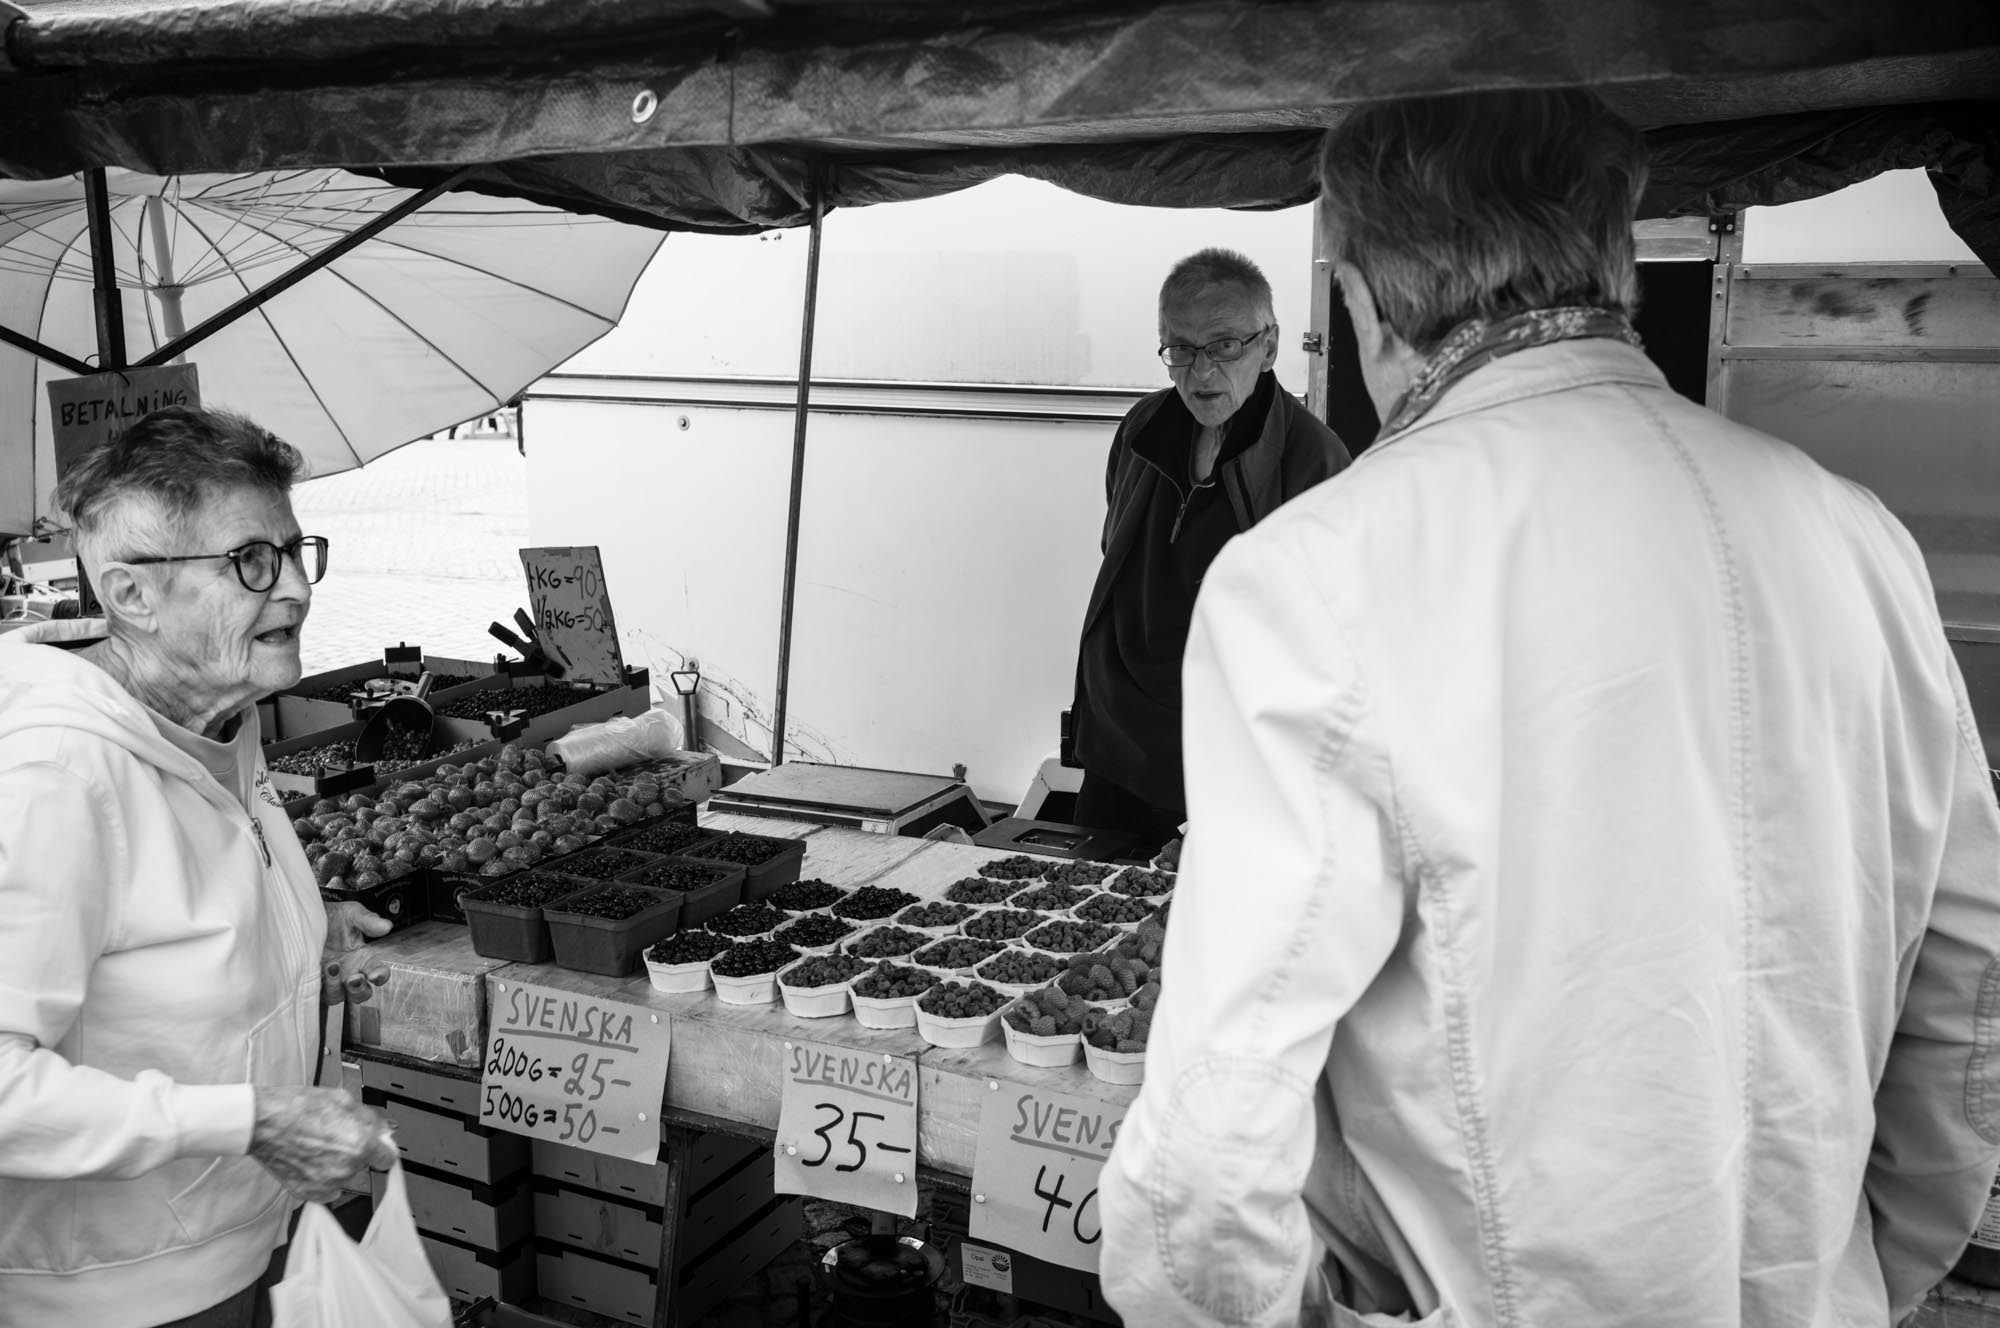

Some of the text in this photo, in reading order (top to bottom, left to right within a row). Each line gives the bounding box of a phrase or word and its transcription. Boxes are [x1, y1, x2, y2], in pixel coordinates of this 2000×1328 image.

[61, 389, 187, 426] BETALNING
[506, 987, 633, 1043] SVENSKA
[790, 1045, 911, 1099] SVENSKA
[801, 1102, 911, 1172] 35-
